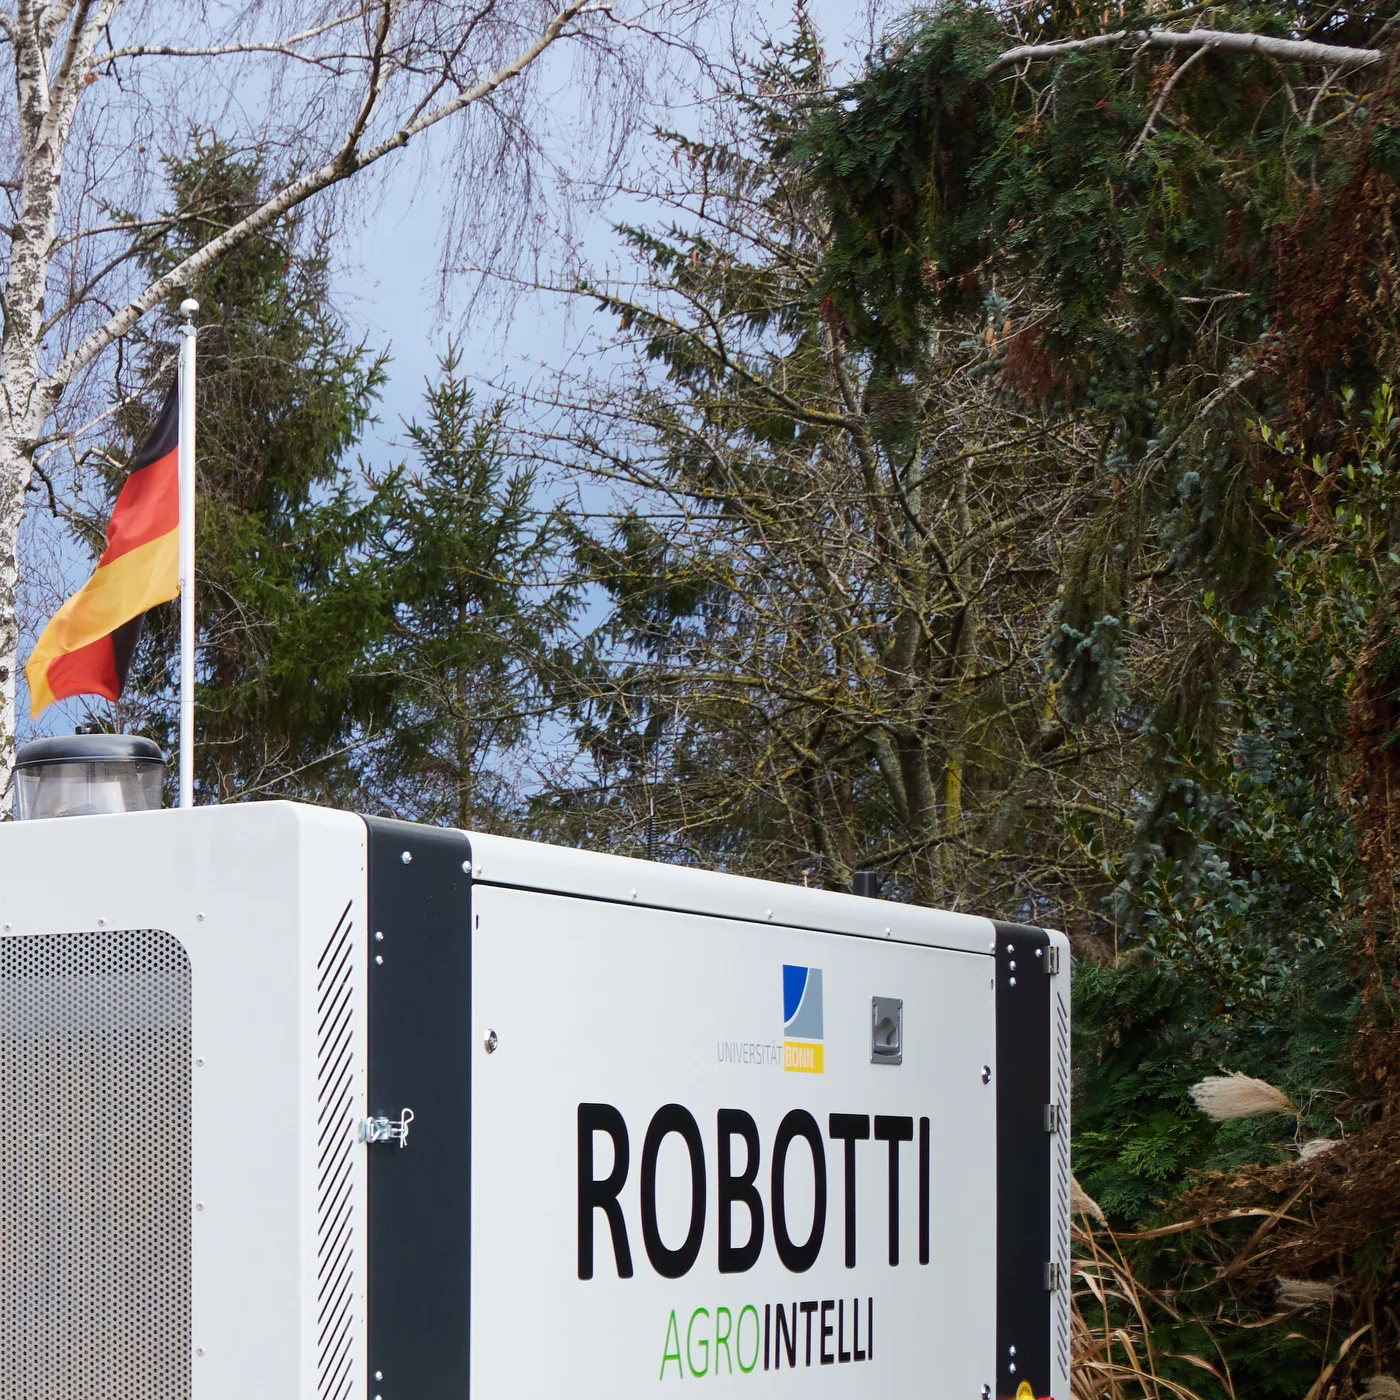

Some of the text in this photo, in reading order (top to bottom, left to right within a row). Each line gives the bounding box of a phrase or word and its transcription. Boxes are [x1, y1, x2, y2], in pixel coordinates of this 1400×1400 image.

[717, 1040, 814, 1069] UNIVERSITÄT BONN
[577, 1102, 930, 1280] ROBOTTI
[659, 1297, 874, 1381] AGROINTELLI
